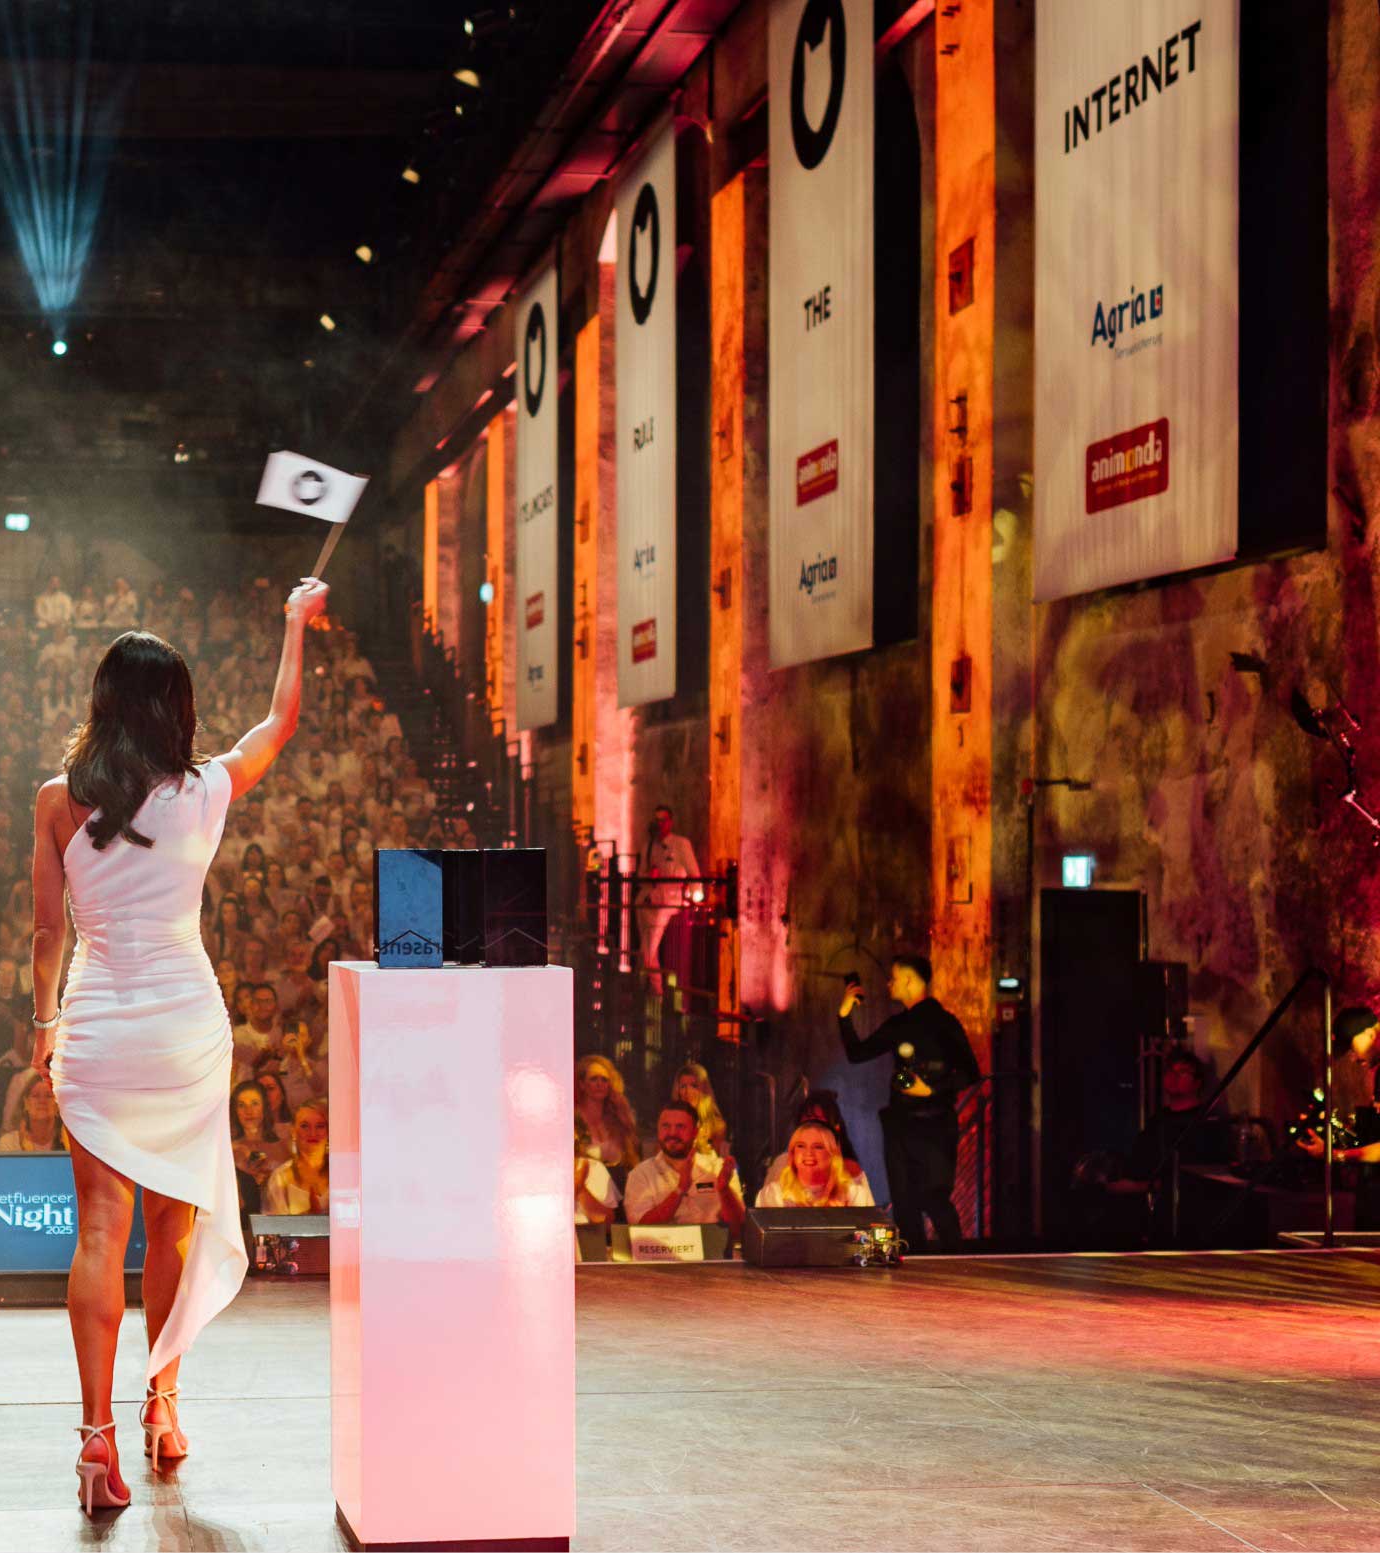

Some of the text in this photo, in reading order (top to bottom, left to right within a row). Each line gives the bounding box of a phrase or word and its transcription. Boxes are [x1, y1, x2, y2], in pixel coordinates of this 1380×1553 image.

[1064, 19, 1202, 154] INTERNET
[804, 285, 832, 332] THE
[1091, 284, 1146, 349] Agria
[1091, 430, 1162, 482] animonda
[799, 552, 828, 595] Agria
[45, 1225, 74, 1235] 2025
[638, 1244, 695, 1254] RESERVIERT
